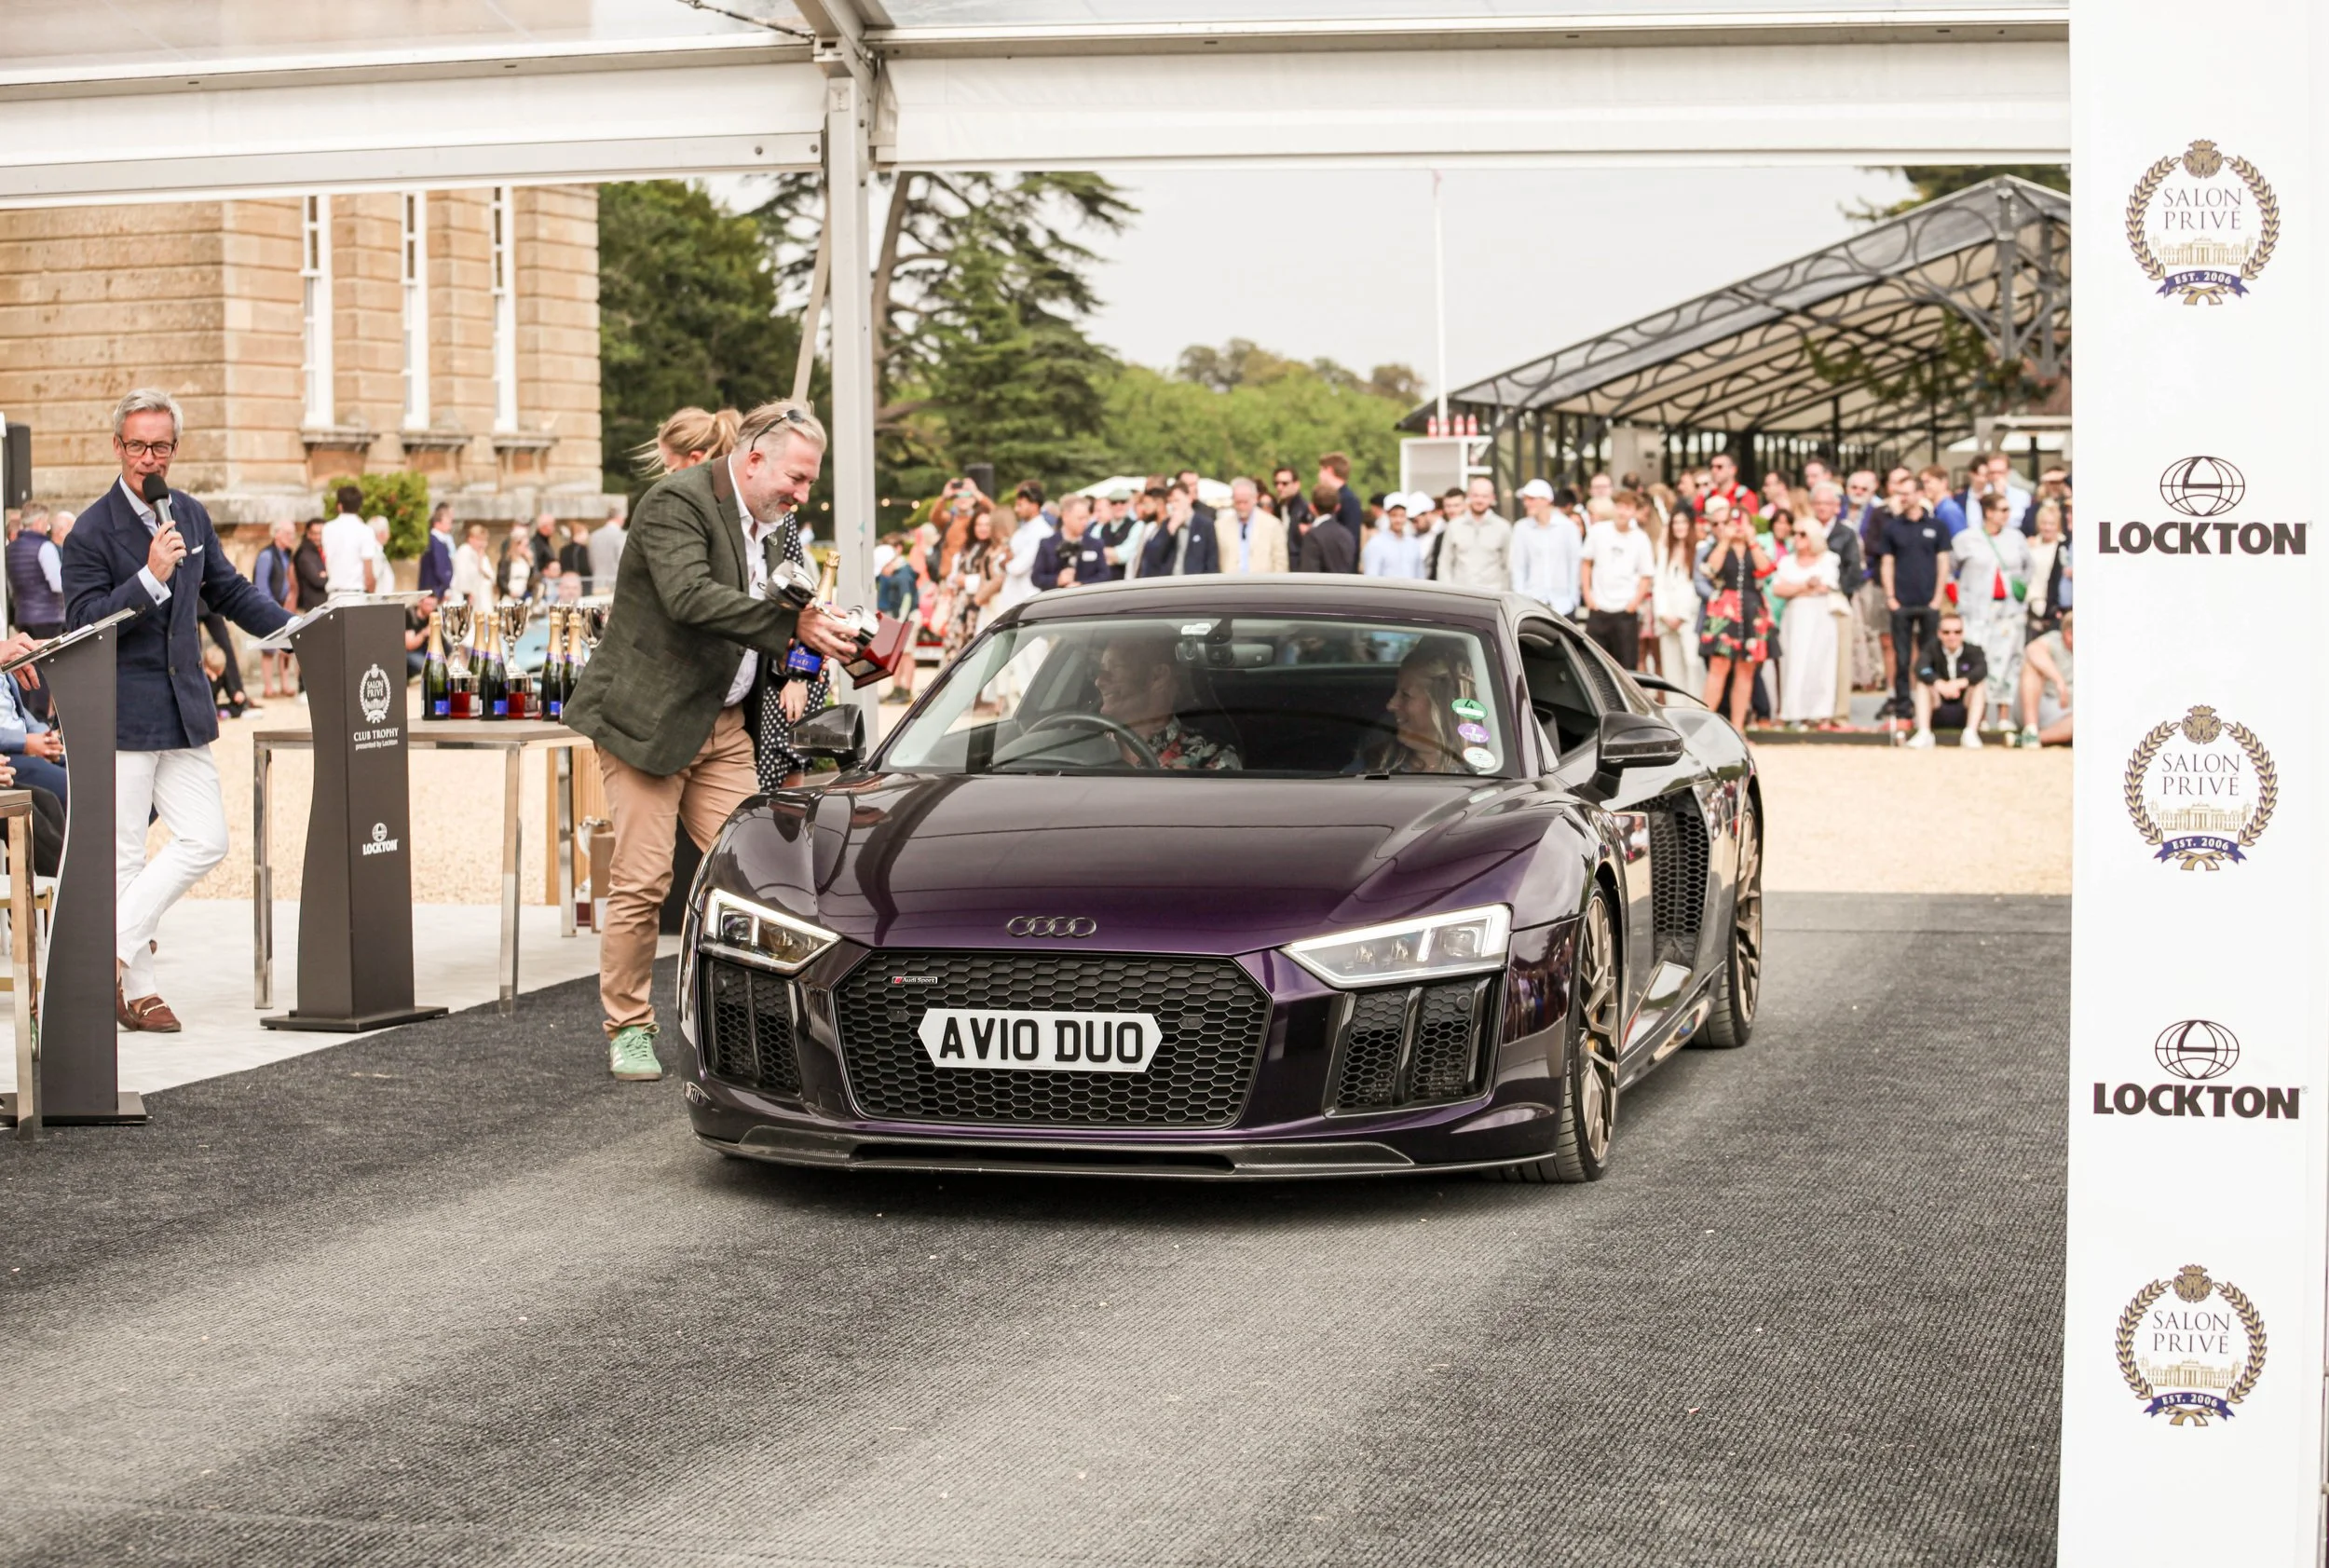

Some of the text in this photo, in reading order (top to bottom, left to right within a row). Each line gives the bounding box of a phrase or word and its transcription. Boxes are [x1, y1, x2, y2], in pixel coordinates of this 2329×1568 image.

[2163, 187, 2241, 208] SALON
[2164, 207, 2241, 230] PRIVÉ
[2174, 271, 2232, 285] EST. 2006
[2098, 522, 2307, 554] LOCKTON
[353, 727, 399, 742] CLUB TROPHY
[2162, 753, 2240, 772] SALON
[2163, 772, 2240, 796] PRIVÉ
[362, 839, 399, 855] LOCKTON
[2172, 838, 2229, 851] EST. 2006
[1055, 1019, 1143, 1063] DUO
[2093, 1083, 2300, 1120] LOCKTON
[2153, 1310, 2229, 1331] SALON
[2153, 1331, 2229, 1354] PRIVÉ
[2161, 1394, 2218, 1408] EST. 2006
